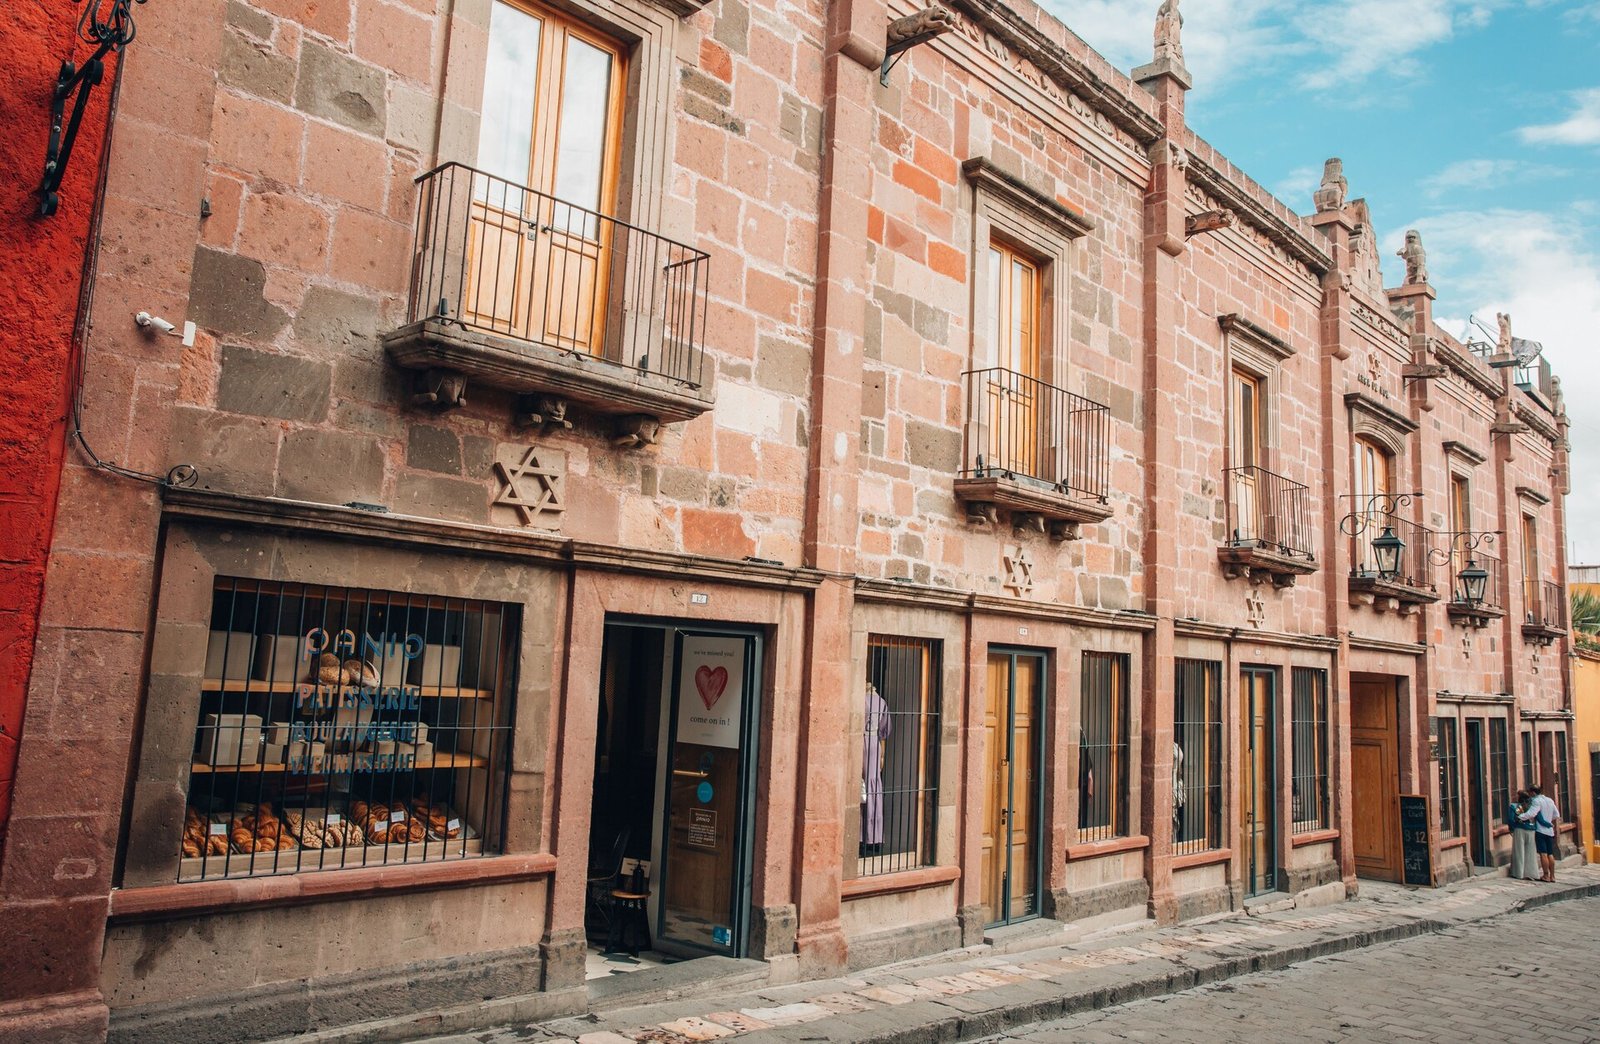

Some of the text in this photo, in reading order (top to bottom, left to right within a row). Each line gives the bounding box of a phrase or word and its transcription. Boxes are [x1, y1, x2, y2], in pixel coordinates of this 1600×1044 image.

[303, 627, 424, 662] PANIO
[296, 684, 421, 711] PATISSERIE
[690, 716, 708, 724] come
[708, 717, 718, 725] on
[719, 716, 726, 726] in
